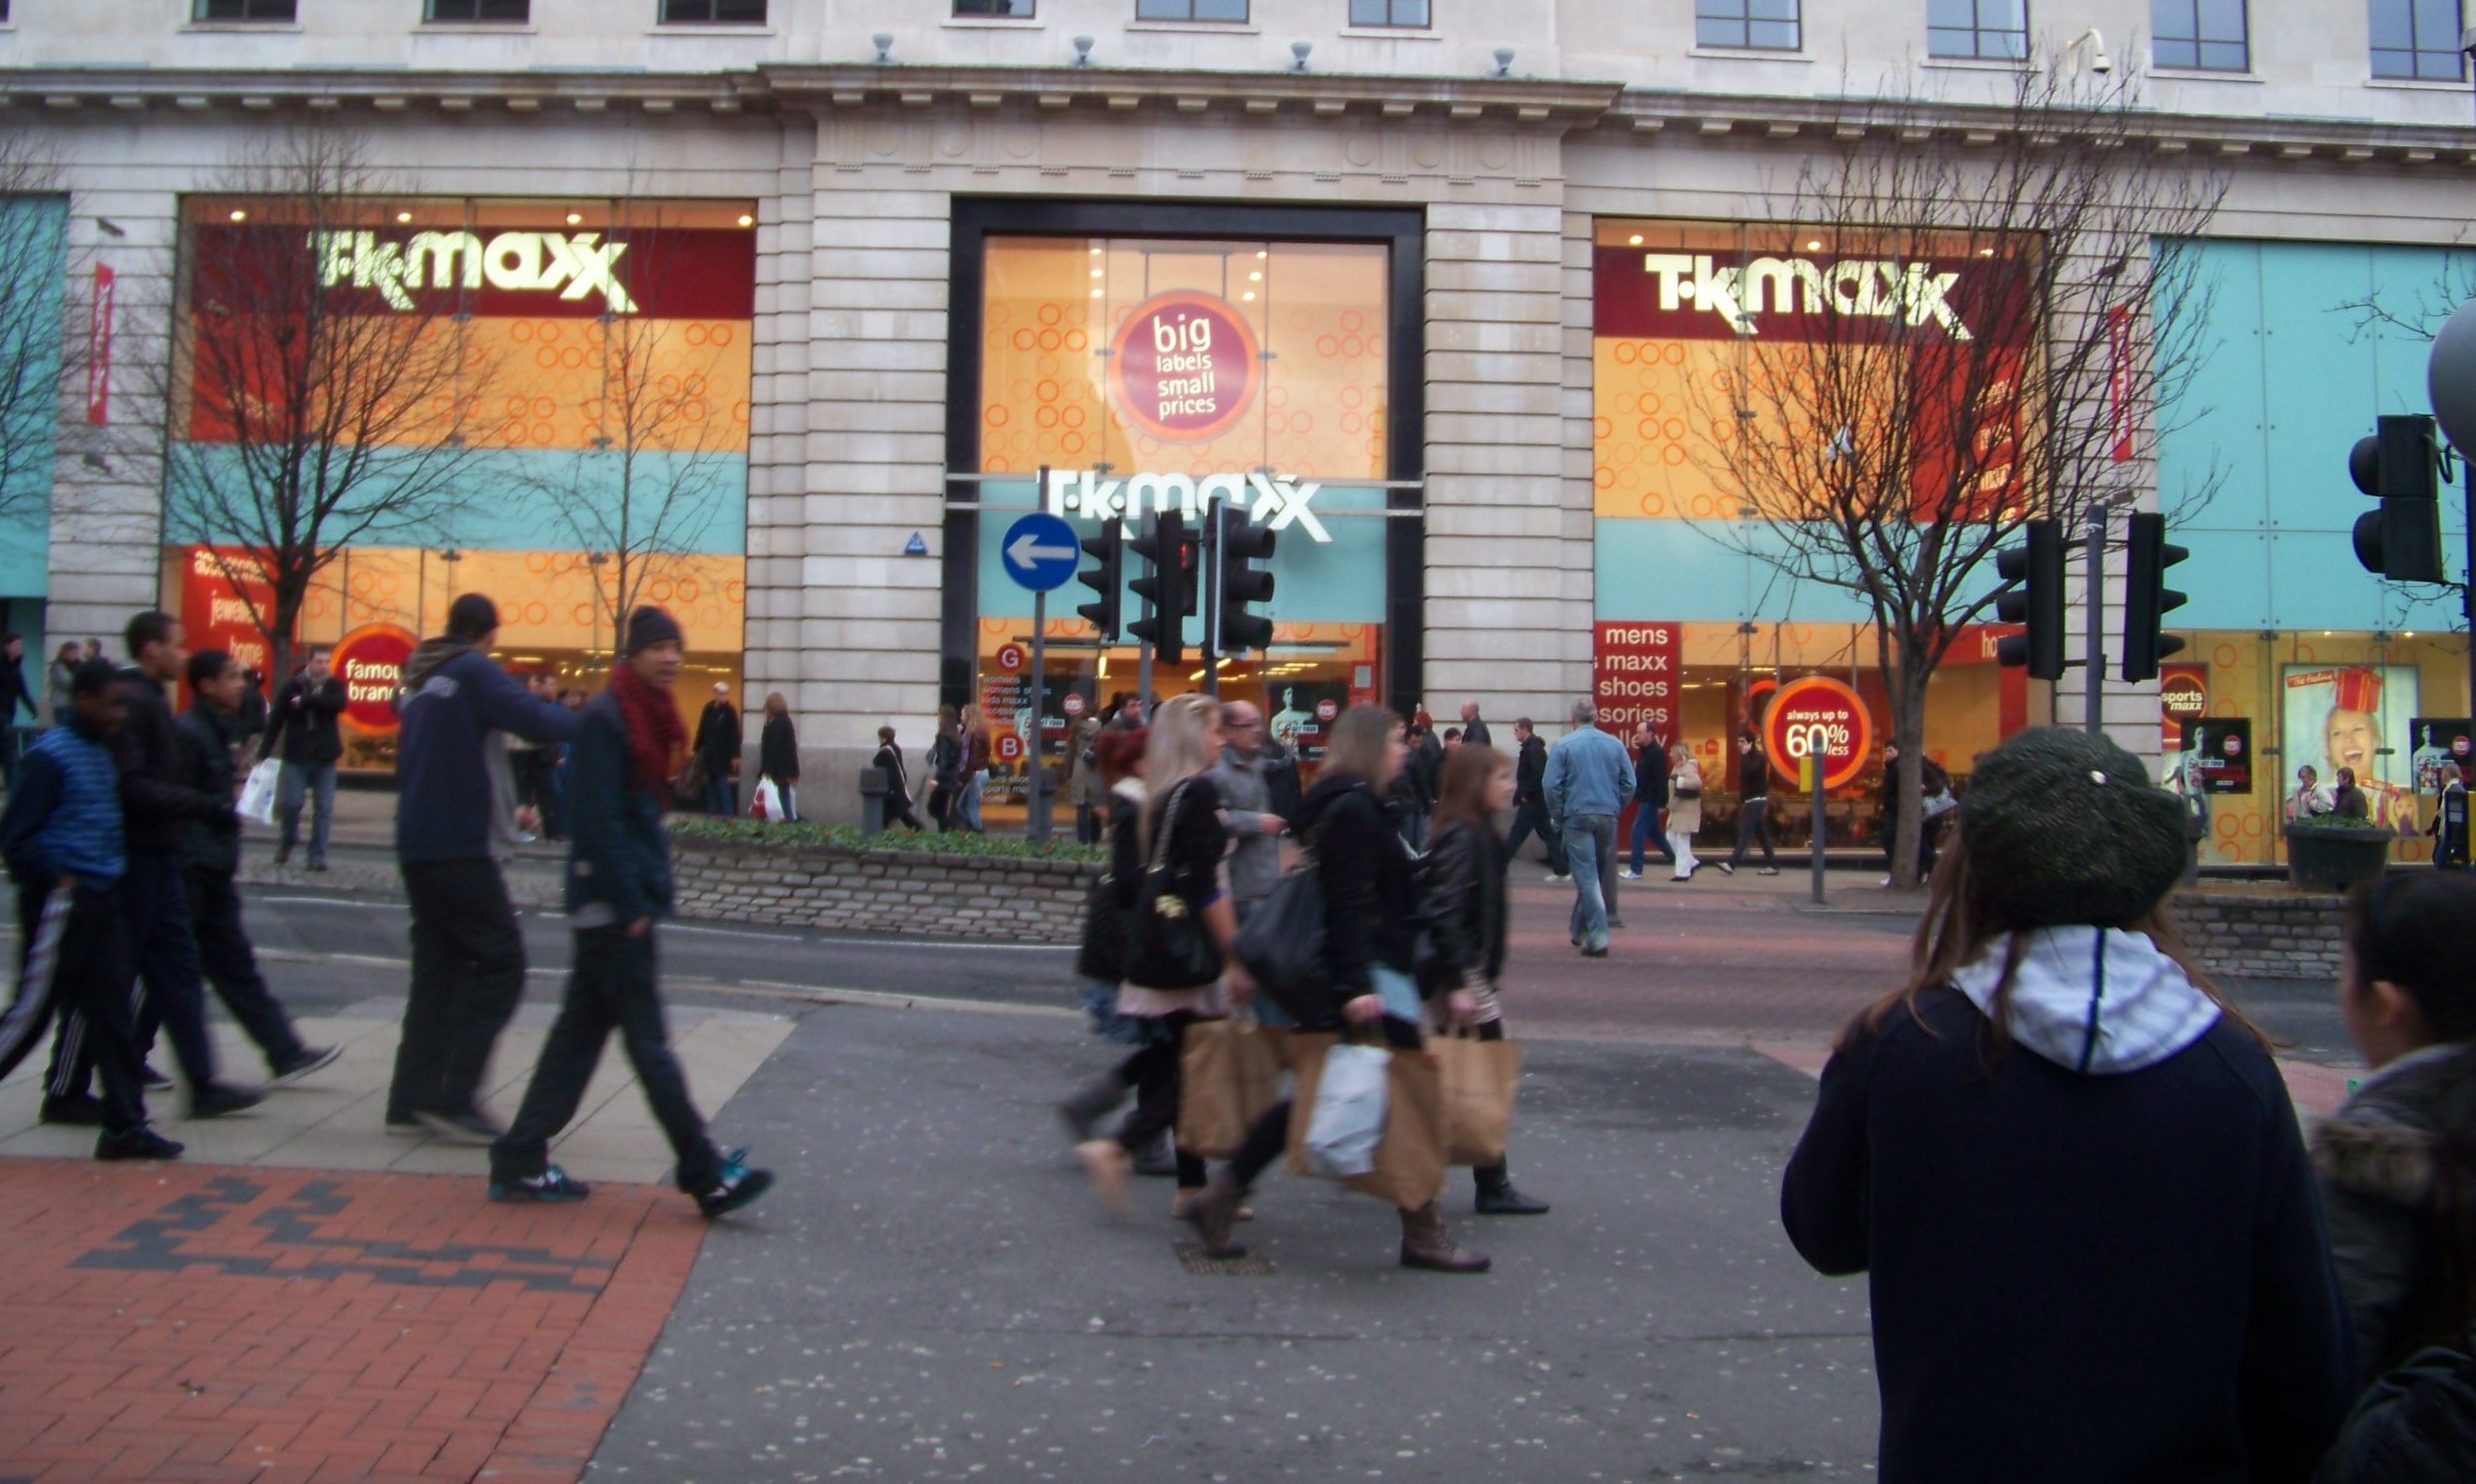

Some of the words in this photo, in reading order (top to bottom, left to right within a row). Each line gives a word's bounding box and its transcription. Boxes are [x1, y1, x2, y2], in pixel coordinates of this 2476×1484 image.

[1153, 313, 1212, 353] big
[1156, 353, 1212, 373] labels
[1157, 371, 1215, 397] small
[1159, 396, 1217, 421] prices
[1605, 628, 1669, 645] mens
[1001, 648, 1019, 668] G
[1605, 655, 1668, 671] maxx
[345, 658, 400, 680] famou
[1600, 676, 1669, 697] shoes
[2161, 690, 2203, 704] sports
[2170, 702, 2202, 711] maxx
[1786, 709, 1820, 722] always
[1822, 711, 1835, 722] up
[1837, 709, 1849, 720] to
[1002, 738, 1018, 756] B
[1827, 744, 1849, 756] less
